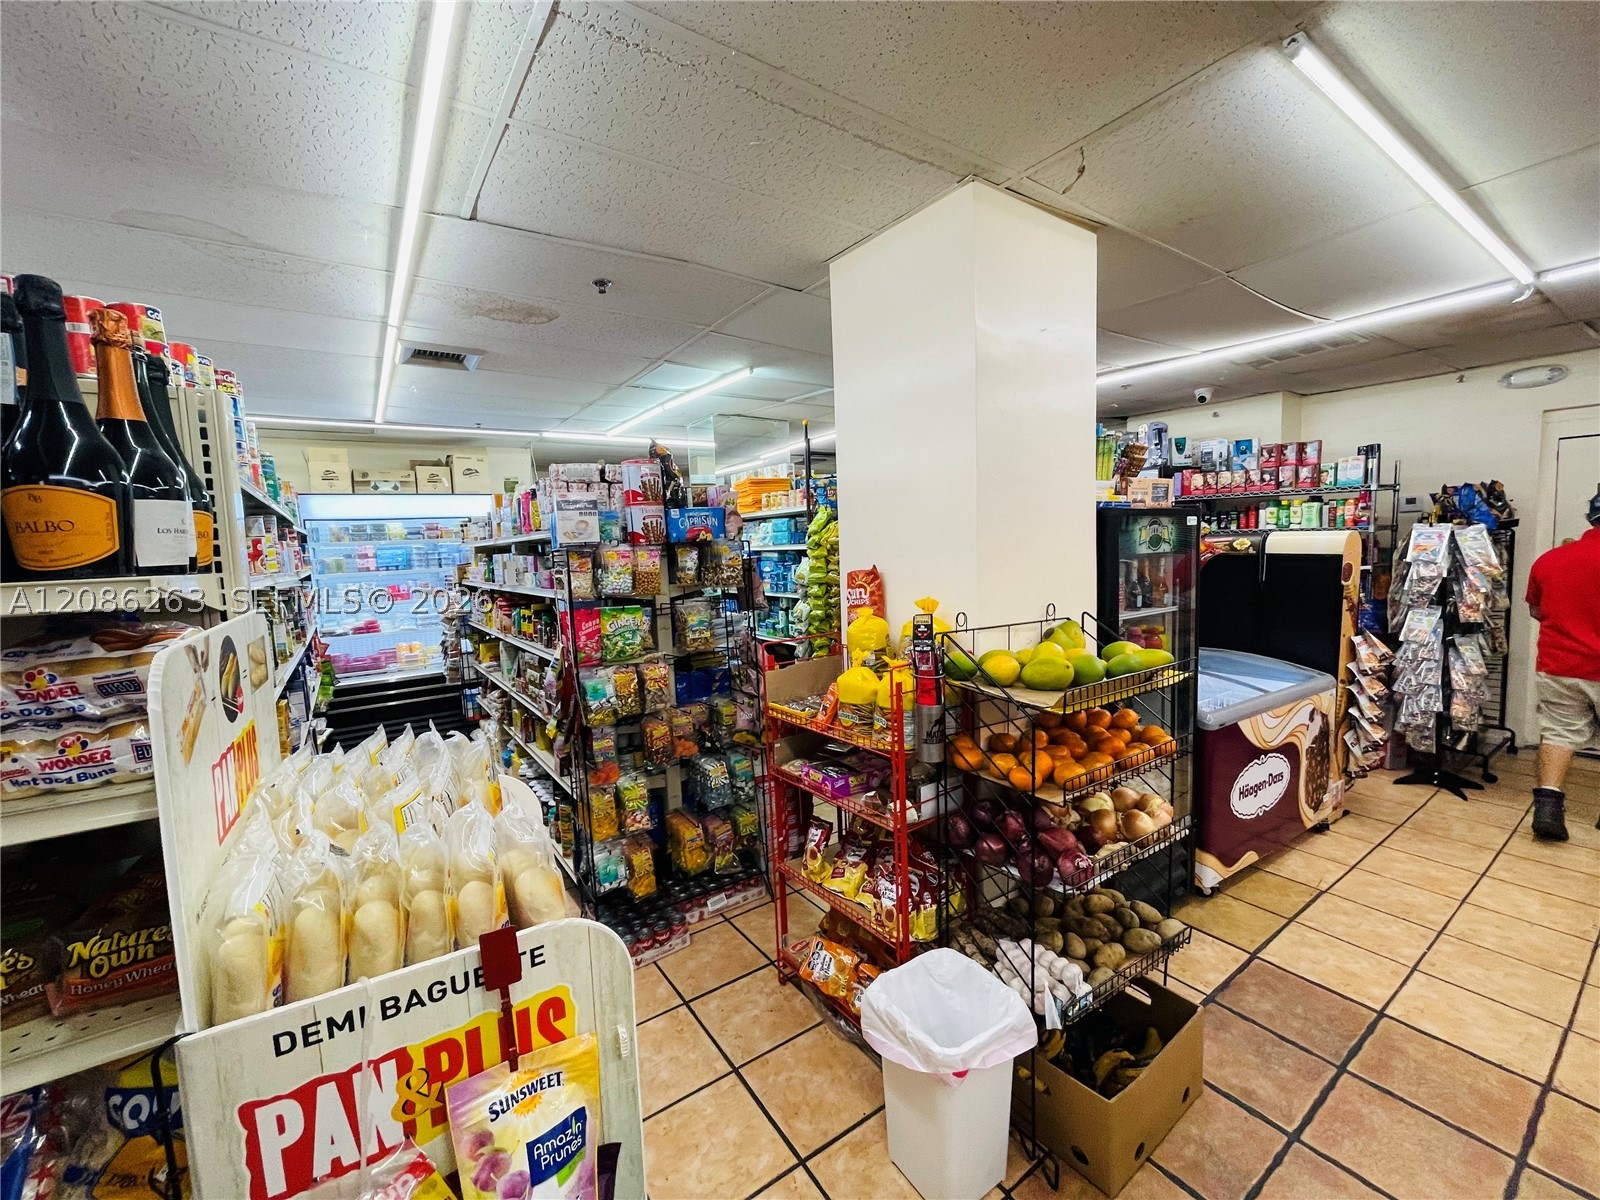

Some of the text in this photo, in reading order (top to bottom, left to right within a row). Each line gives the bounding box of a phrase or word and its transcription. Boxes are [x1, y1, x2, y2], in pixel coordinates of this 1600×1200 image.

[15, 519, 75, 534] BALBO
[607, 617, 641, 632] GINGER
[9, 767, 117, 787] Hot Dog Buns
[38, 749, 112, 771] WONDER
[214, 747, 240, 839] PAN
[1239, 772, 1284, 801] Häagen-Dazs
[67, 925, 173, 968] Nature
[89, 943, 155, 979] Own
[71, 978, 123, 996] Honey
[273, 944, 546, 1058] DEMI BAGUETE
[488, 1071, 564, 1123] SUNSWEET
[254, 1056, 404, 1198] PAN
[540, 1134, 582, 1170] Prunes
